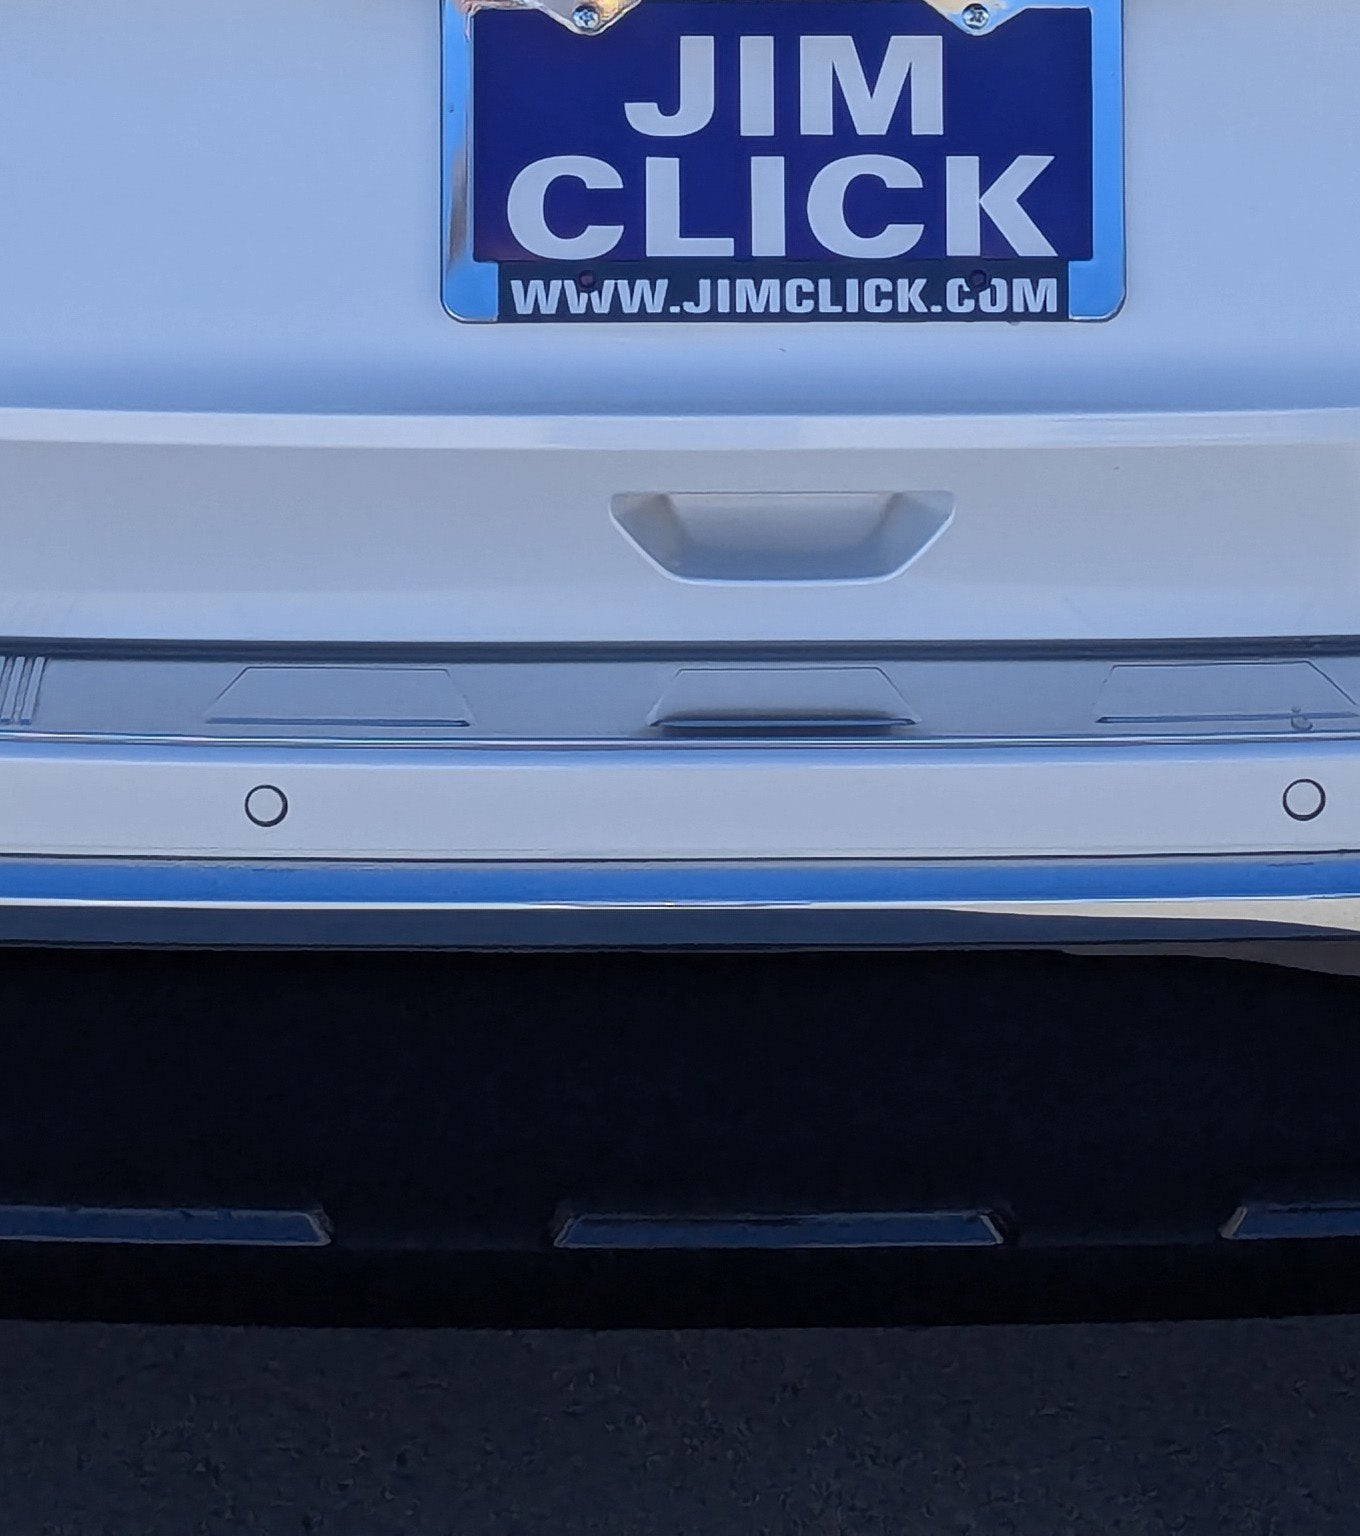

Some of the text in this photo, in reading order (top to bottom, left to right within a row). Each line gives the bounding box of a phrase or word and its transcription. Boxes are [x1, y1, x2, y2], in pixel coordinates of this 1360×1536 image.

[624, 35, 944, 136] JIM
[507, 154, 1059, 260] CLICK
[510, 277, 1058, 314] WWW.JIMCLICK.COM
